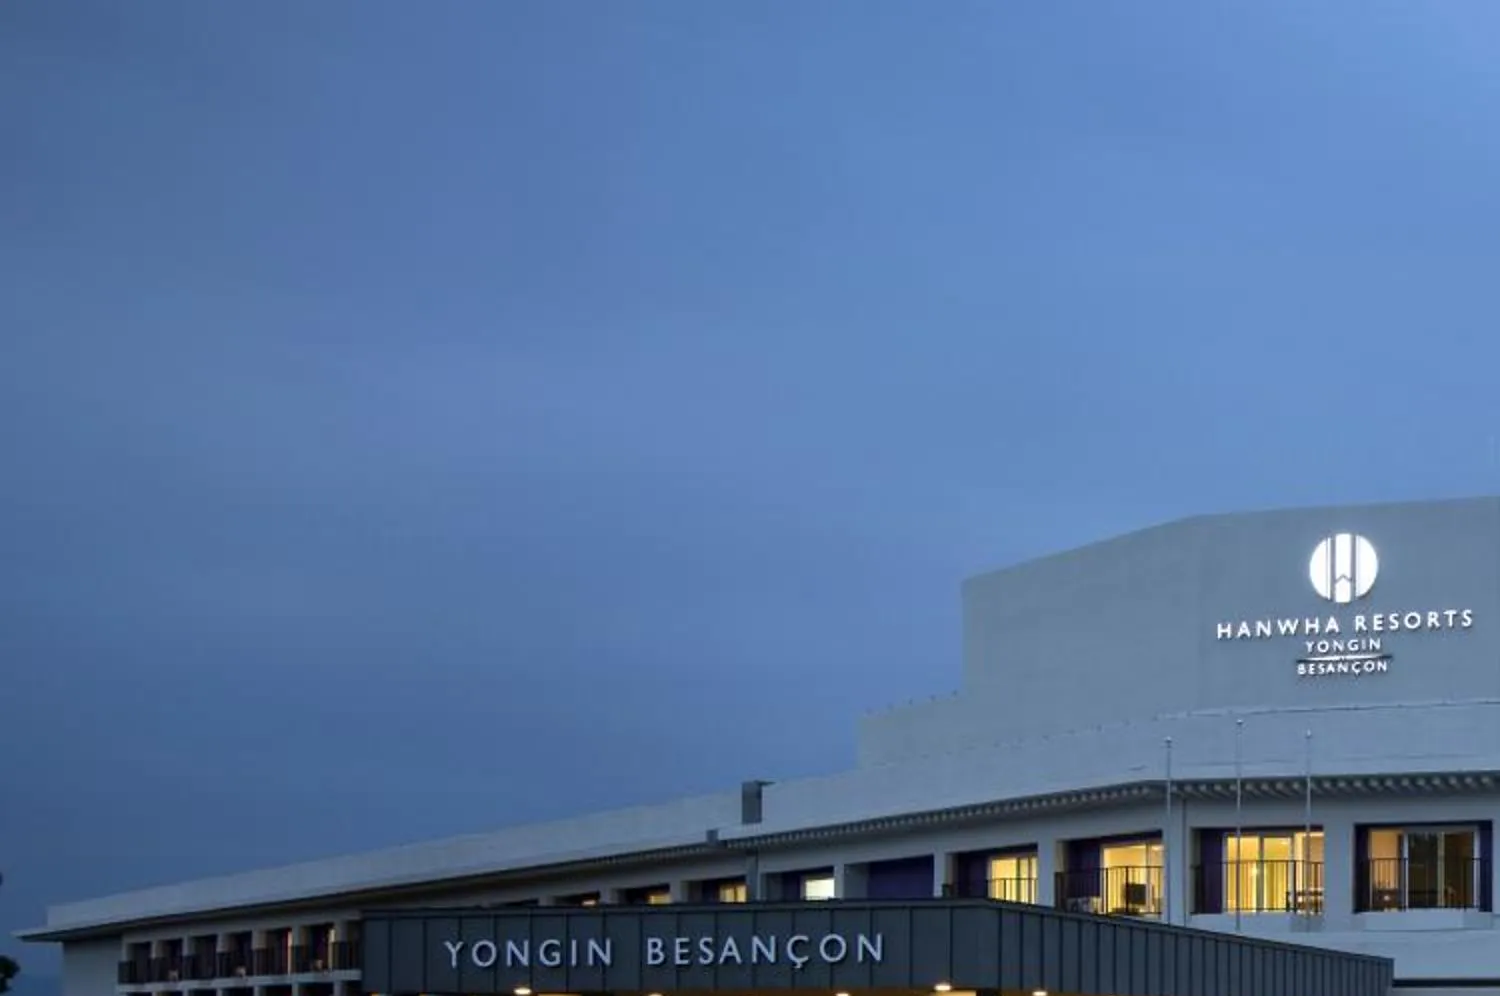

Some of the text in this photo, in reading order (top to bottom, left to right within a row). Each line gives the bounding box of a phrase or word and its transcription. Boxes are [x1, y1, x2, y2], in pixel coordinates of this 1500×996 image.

[1217, 608, 1473, 640] HANWHA RESORTS
[1304, 637, 1382, 654] YONGIN
[1297, 660, 1388, 676] BESANÇON
[443, 932, 884, 970] YONGIN BESANÇON
